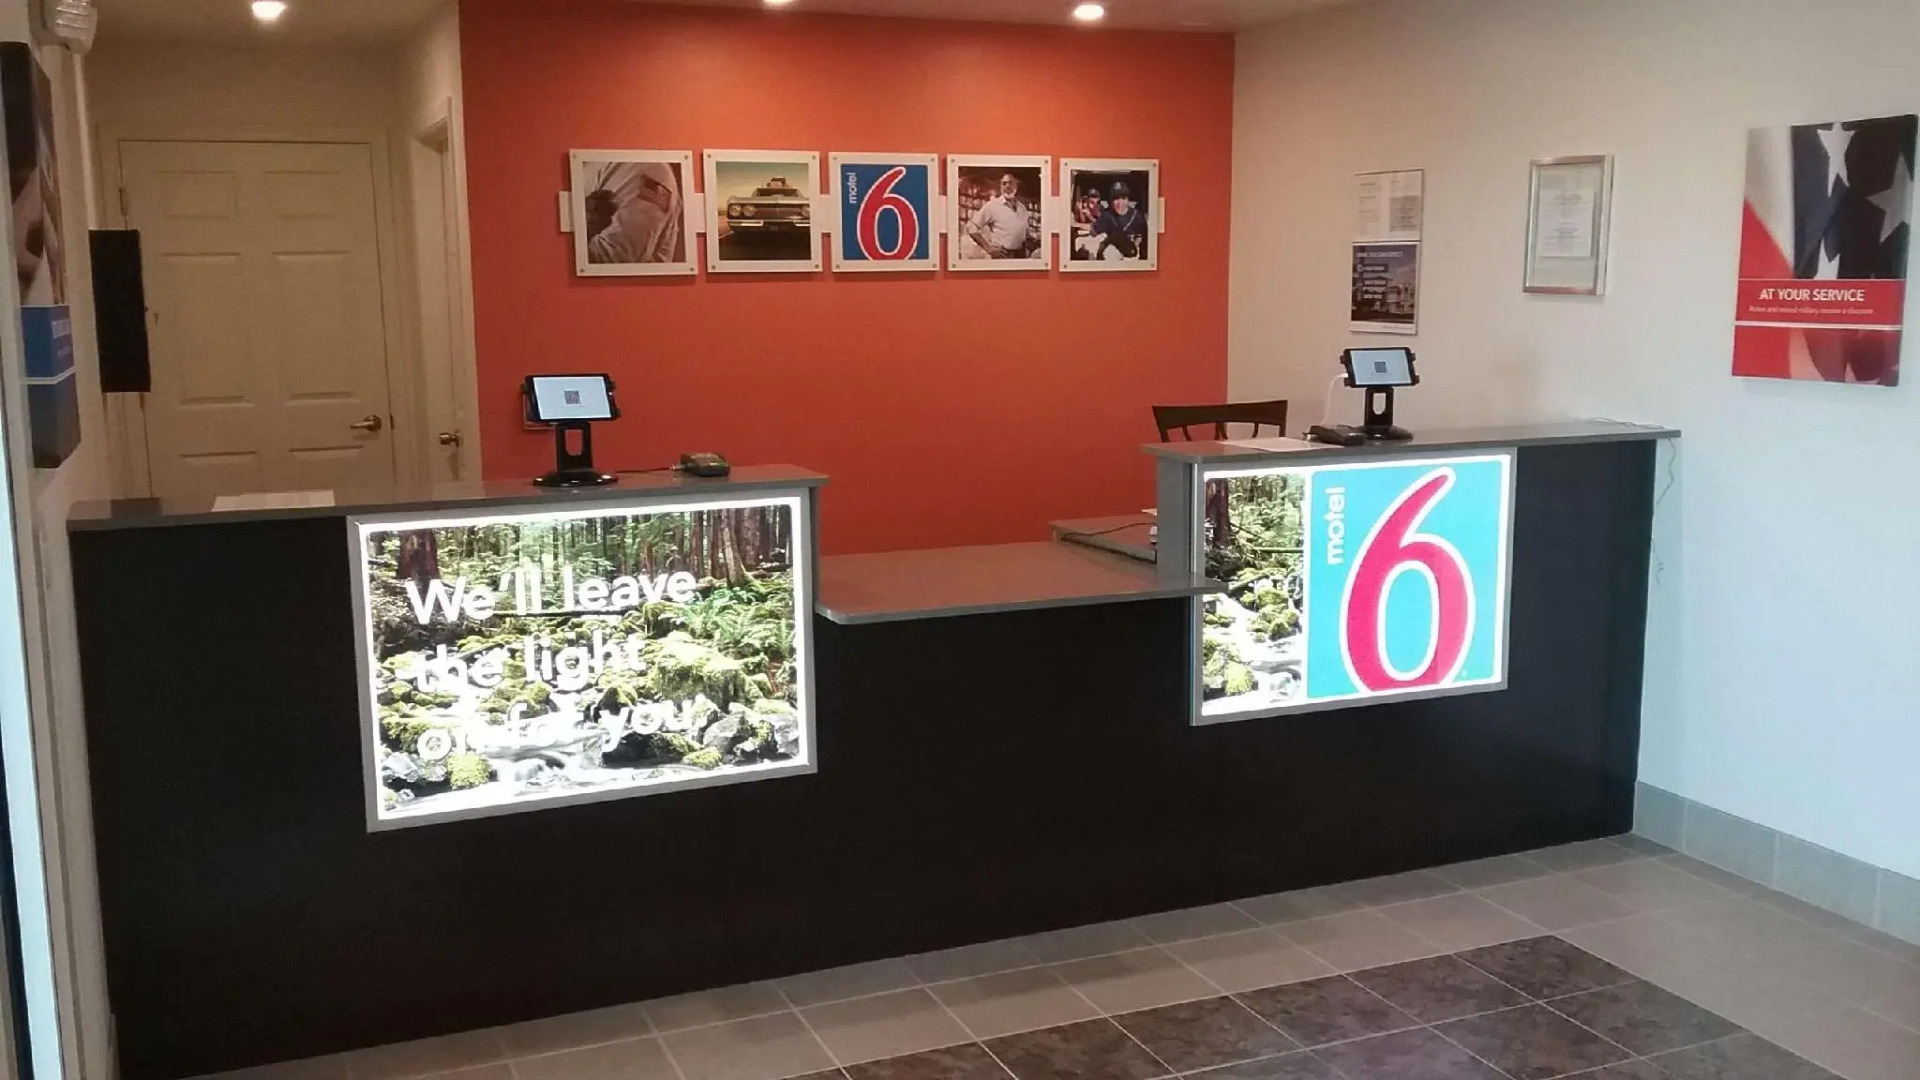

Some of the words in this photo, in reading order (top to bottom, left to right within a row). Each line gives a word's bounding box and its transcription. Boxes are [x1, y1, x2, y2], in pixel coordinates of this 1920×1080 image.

[846, 172, 857, 204] motel
[857, 166, 919, 261] 6
[1759, 288, 1775, 300] AT
[1776, 288, 1811, 301] YOUR
[1812, 289, 1866, 302] SERVICE
[404, 562, 542, 625] We'll
[564, 565, 697, 611] leave
[1324, 487, 1346, 565] motel
[1339, 466, 1476, 694] 6
[415, 643, 504, 693] the
[524, 628, 647, 692] light
